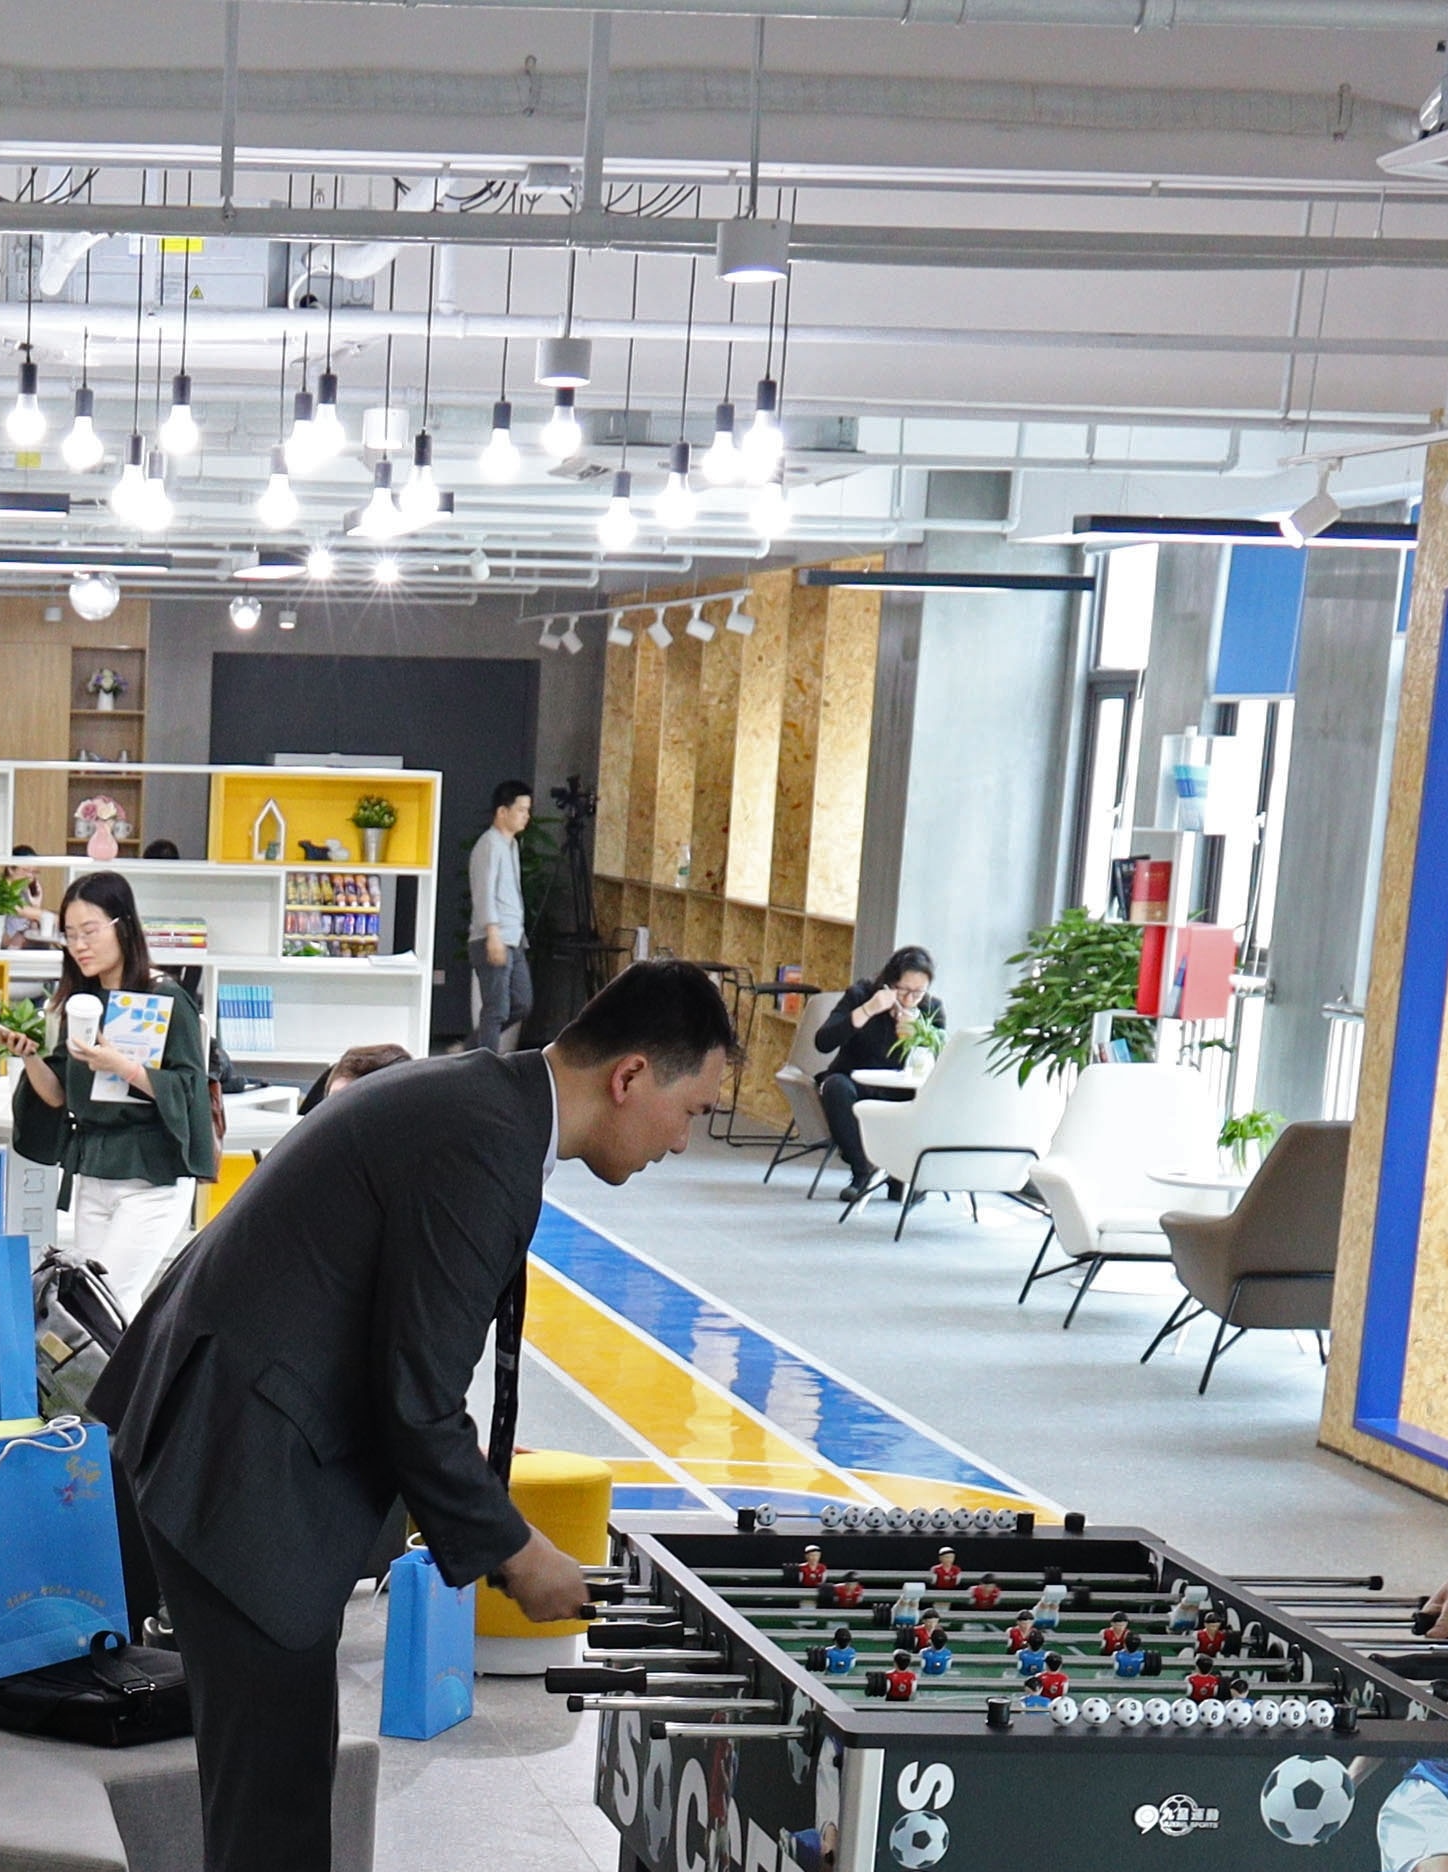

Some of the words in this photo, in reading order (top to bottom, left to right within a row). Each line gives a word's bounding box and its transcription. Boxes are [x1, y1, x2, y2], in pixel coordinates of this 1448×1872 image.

[1063, 1703, 1069, 1712] 1
[1130, 1702, 1137, 1710] 3
[1157, 1713, 1164, 1721] 4
[1186, 1705, 1193, 1714] 5
[1211, 1711, 1218, 1720] 6
[1266, 1711, 1273, 1720] 8
[1293, 1711, 1300, 1720] 9
[1319, 1716, 1329, 1724] 10
